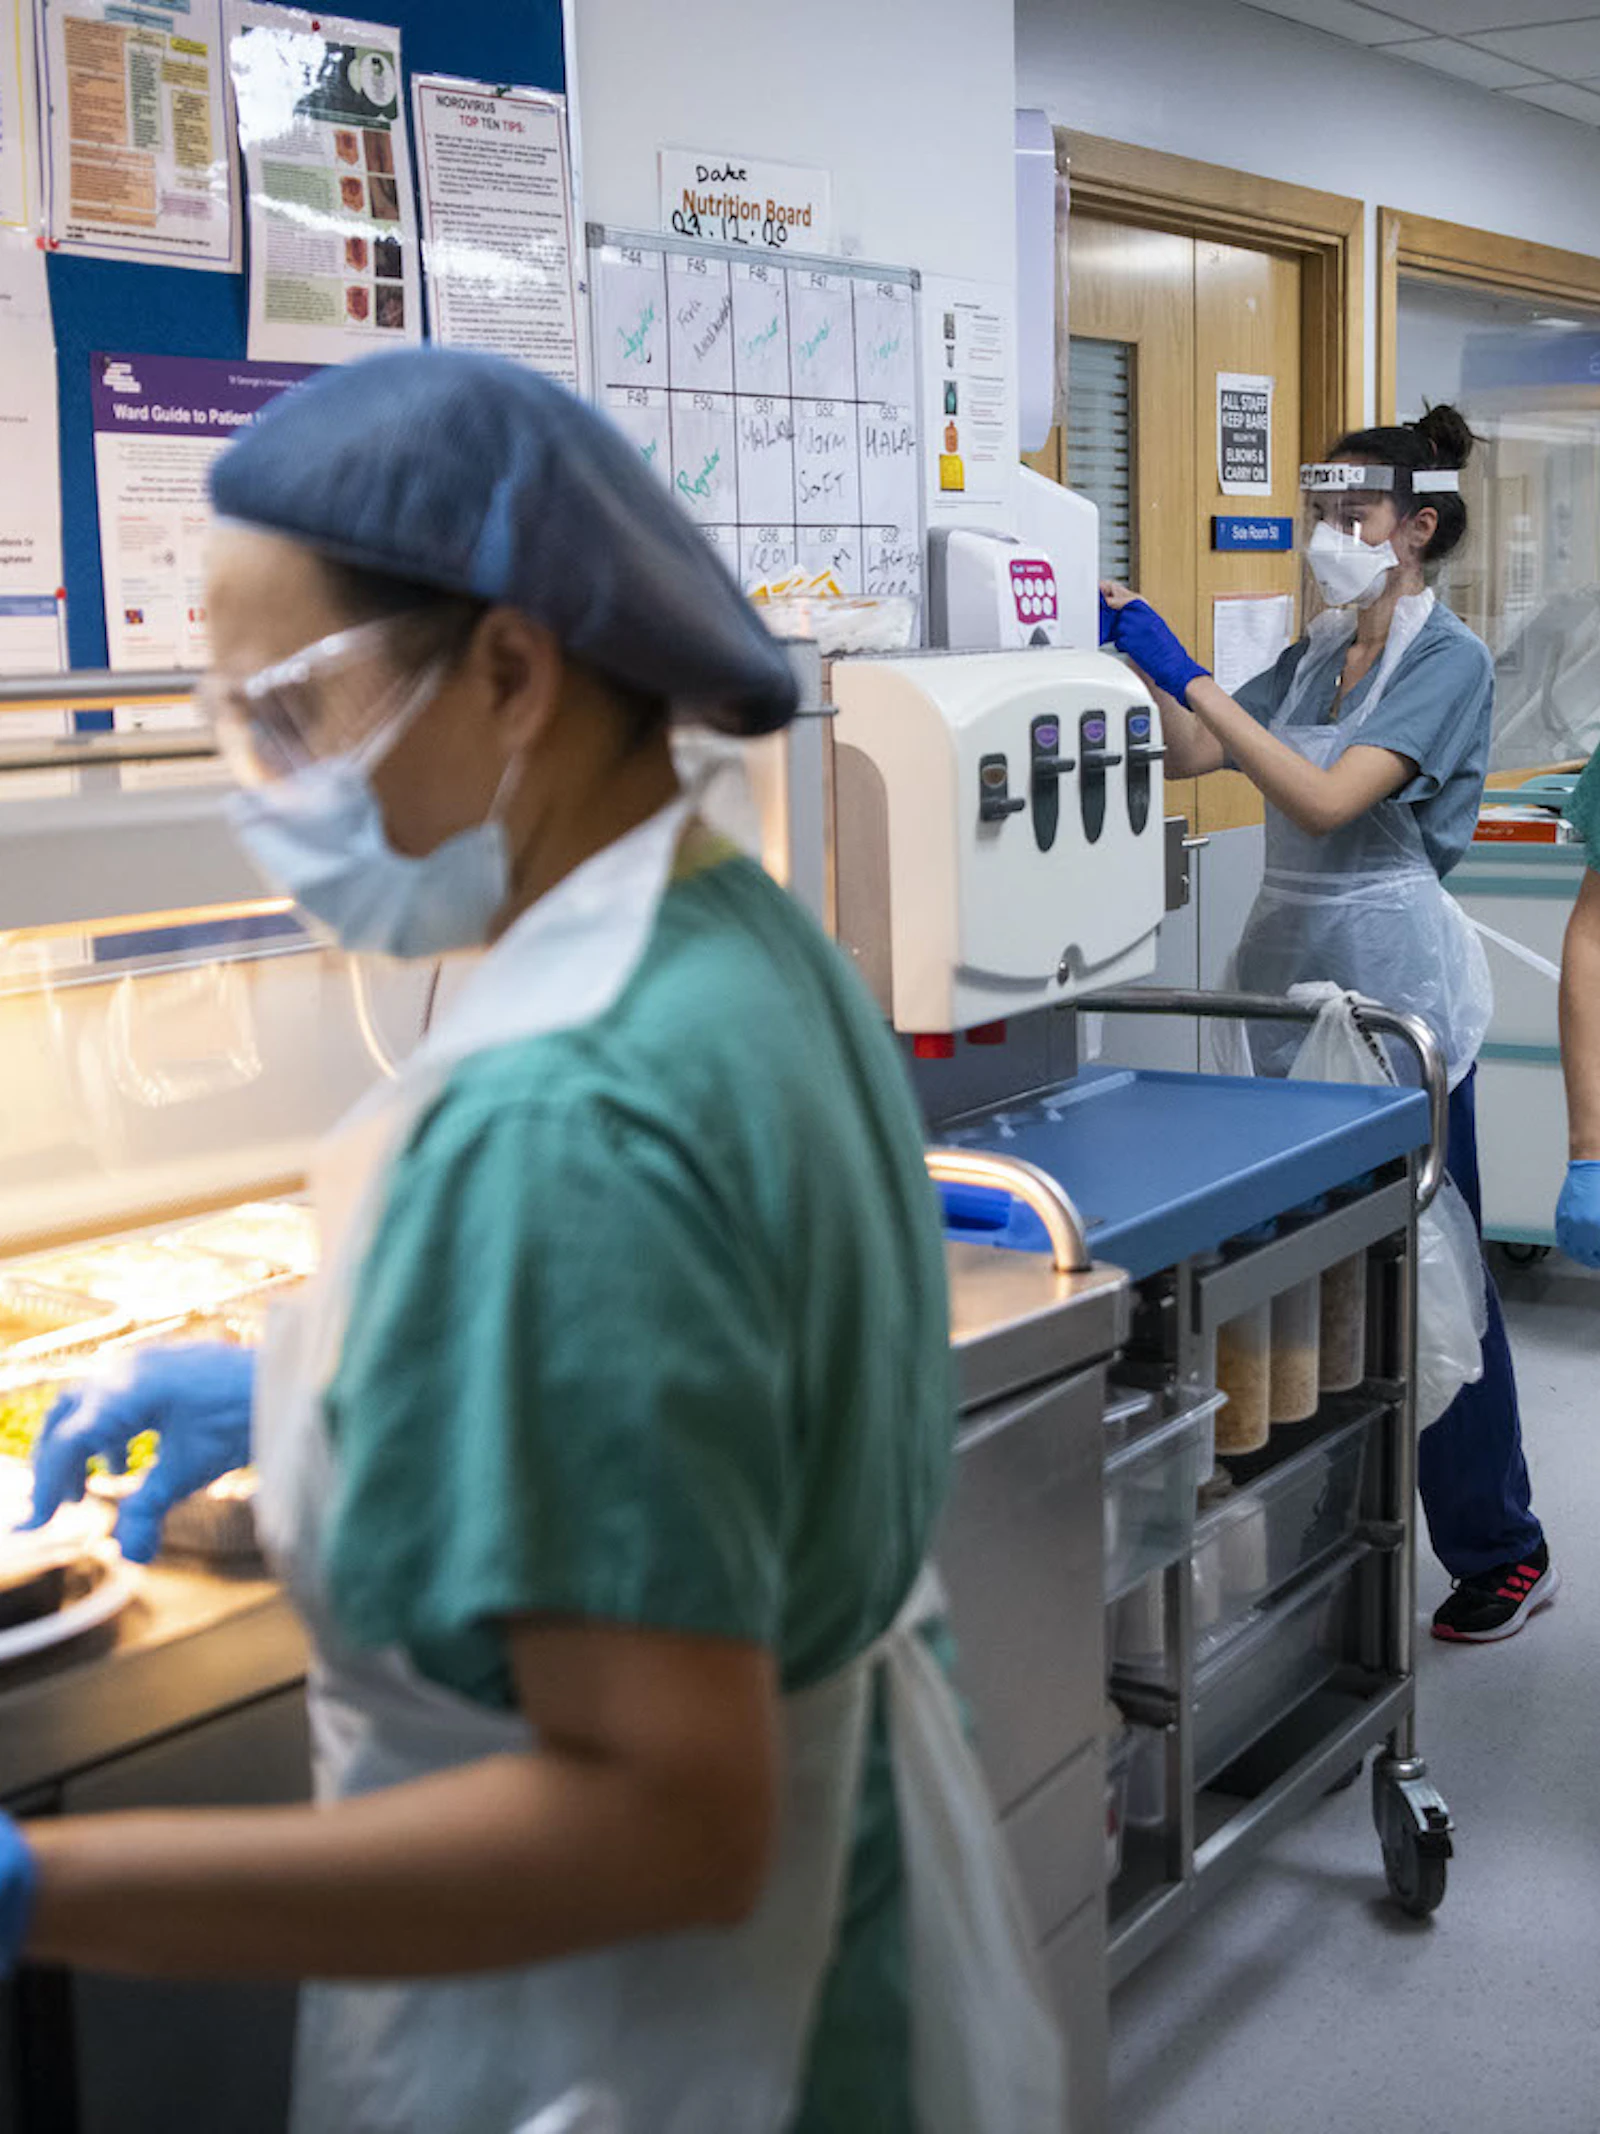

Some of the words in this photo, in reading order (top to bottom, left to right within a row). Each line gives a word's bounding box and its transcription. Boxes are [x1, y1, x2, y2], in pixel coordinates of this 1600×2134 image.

[435, 94, 496, 114] NOROVIRUS
[460, 115, 478, 127] TOP
[480, 118, 500, 130] TEN
[696, 163, 747, 183] Date
[682, 188, 761, 221] Nutrition
[766, 198, 811, 227] Board
[687, 257, 706, 274] F45
[1223, 393, 1240, 410] ALL
[1241, 395, 1267, 414] STAFF
[112, 402, 149, 421] Ward
[151, 405, 191, 424] Guide
[193, 407, 208, 424] to
[209, 408, 253, 426] Patient
[1222, 411, 1244, 429] KEEP
[1245, 412, 1267, 430] BARE
[1226, 447, 1258, 464] ELBOWS
[1225, 465, 1251, 480] CARRY
[1248, 524, 1269, 540] Room
